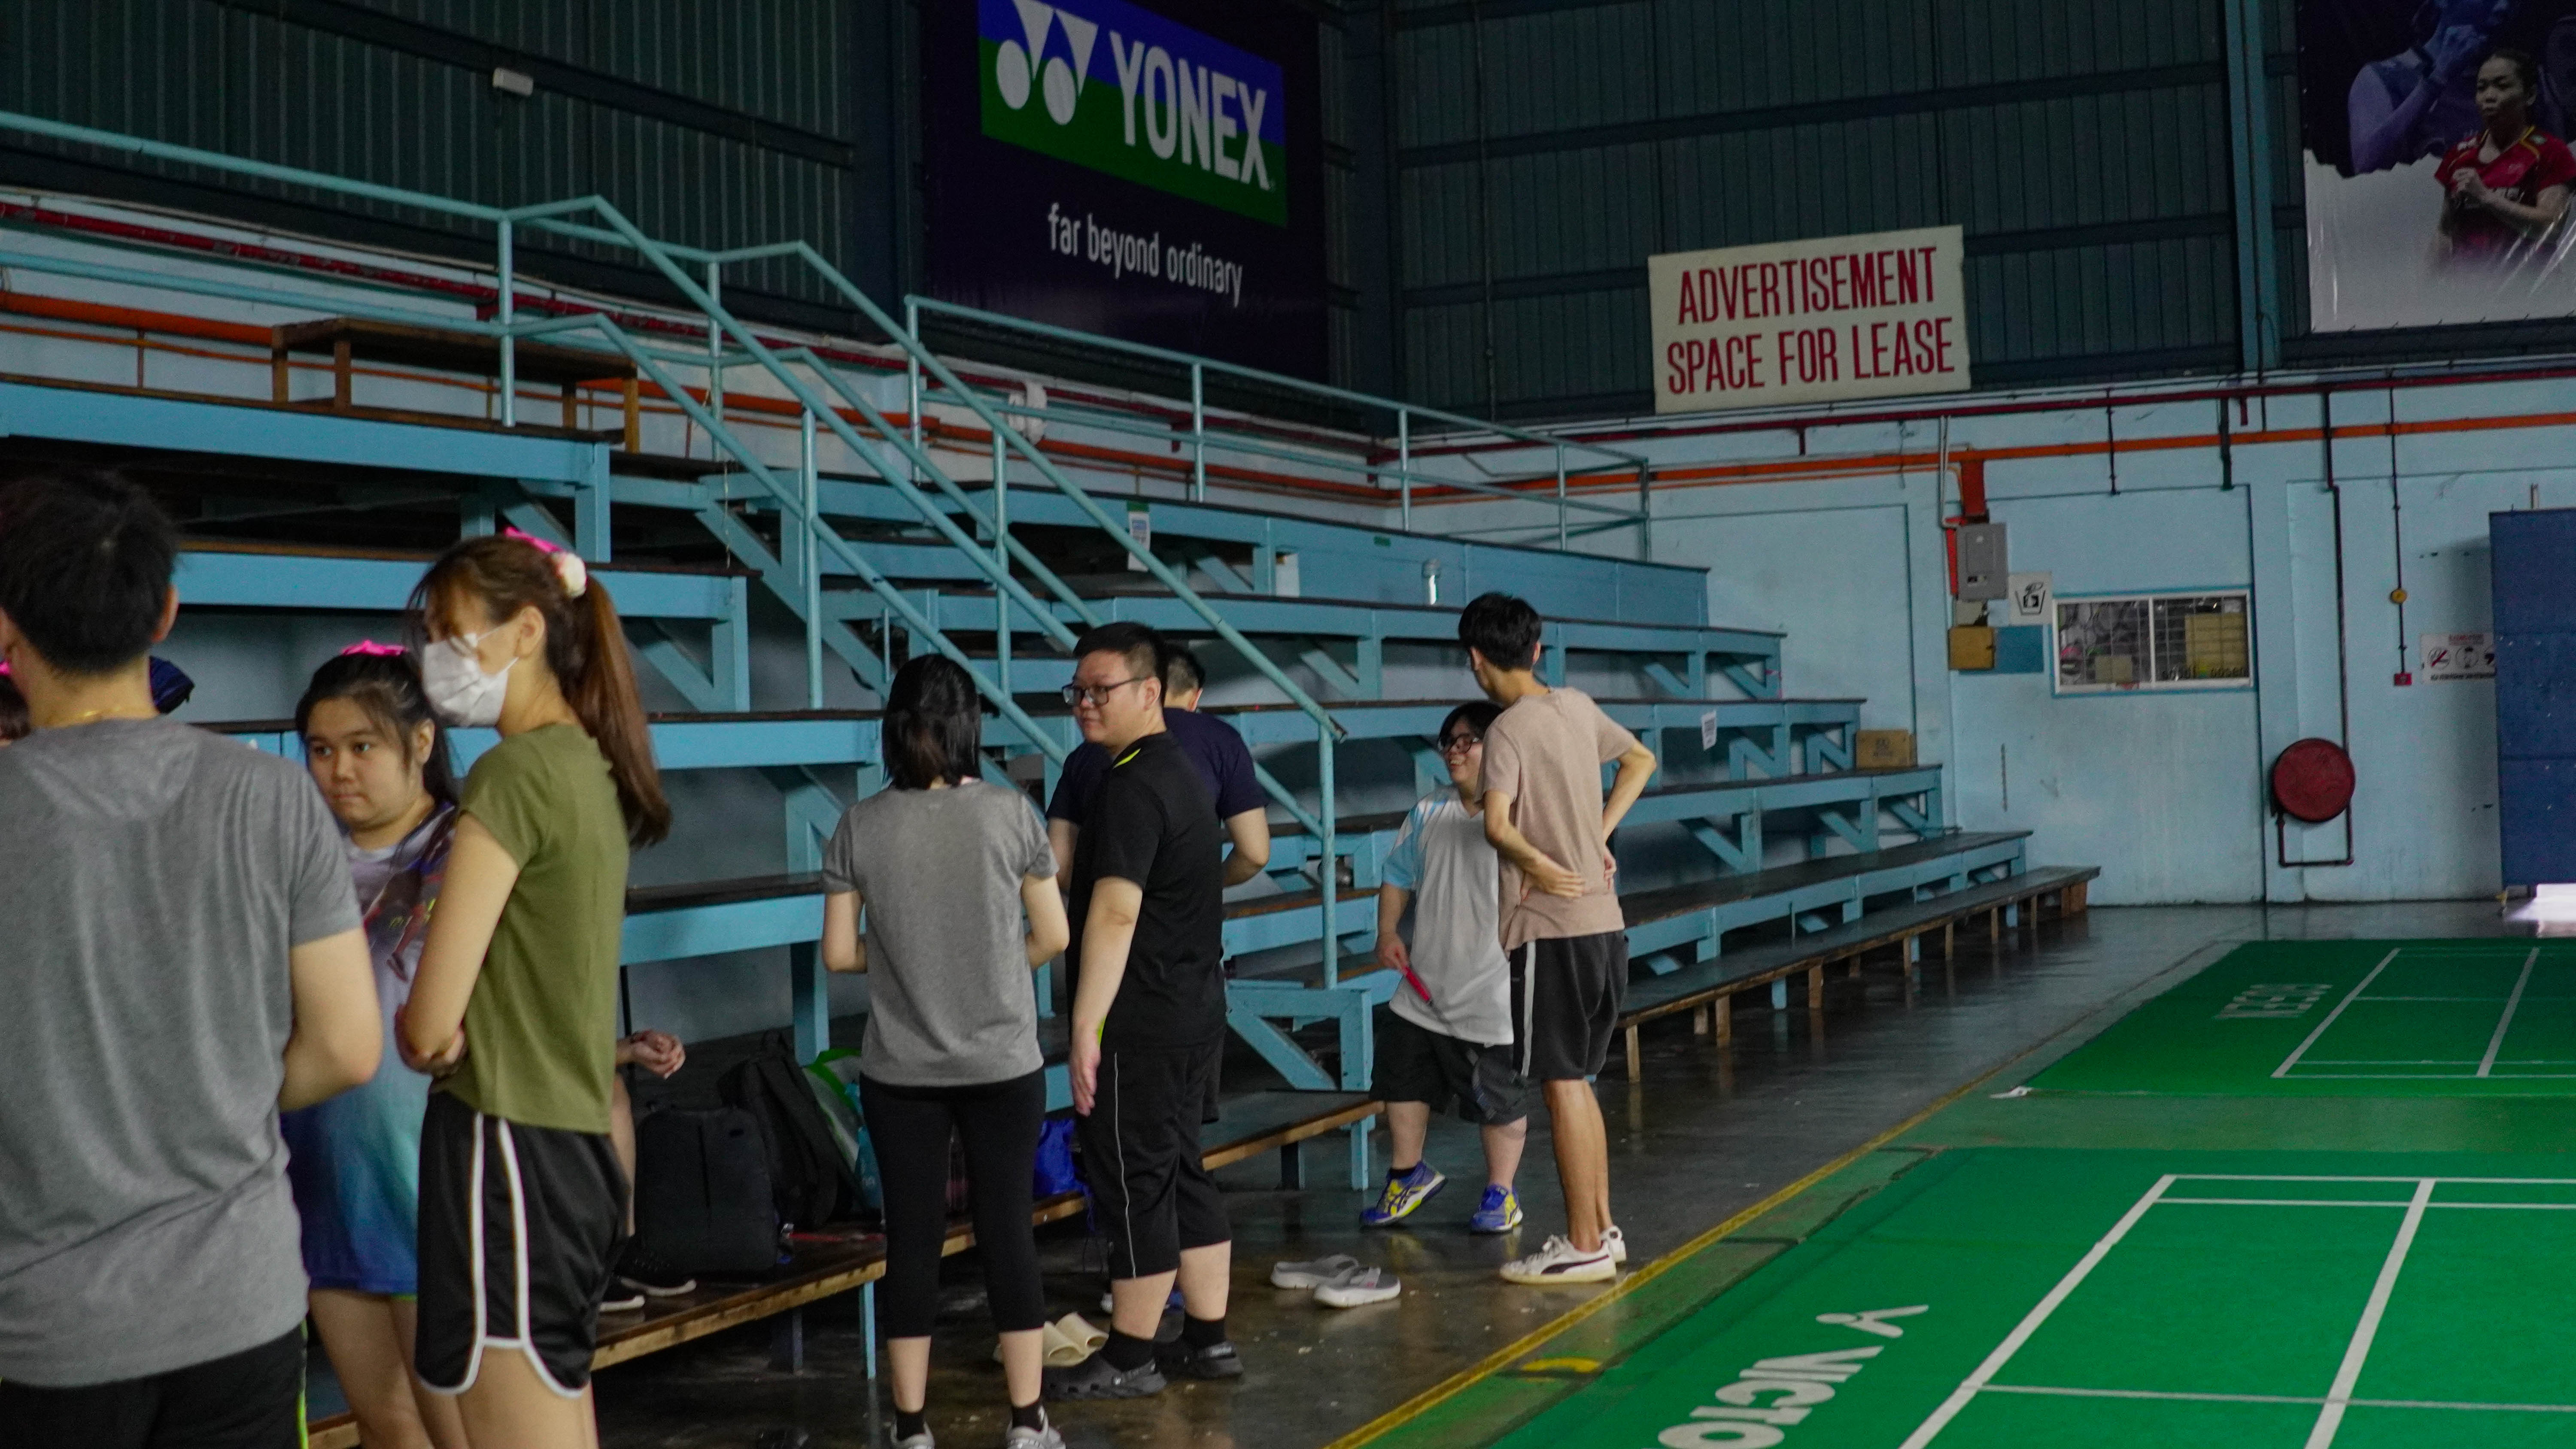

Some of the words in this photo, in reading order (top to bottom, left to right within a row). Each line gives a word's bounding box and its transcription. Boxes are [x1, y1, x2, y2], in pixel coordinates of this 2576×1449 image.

[1109, 30, 1270, 191] YONEX
[1047, 202, 1081, 257] far
[1087, 213, 1160, 279] beyond
[1166, 243, 1243, 308] ordinary
[1678, 246, 1937, 325] ADVERTISEMENT
[1667, 333, 1765, 394] SPACE
[1778, 327, 1839, 385] FOR
[1852, 317, 1955, 379] LEASE
[1641, 1345, 1884, 1449] VICTO
